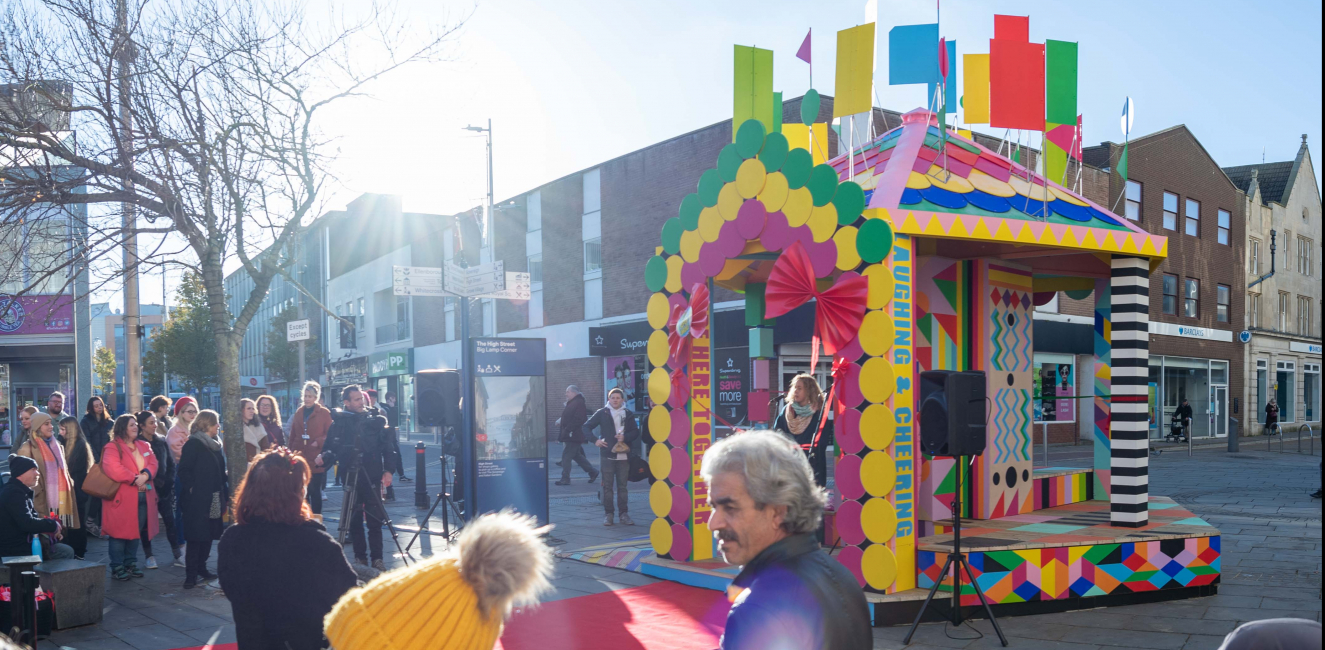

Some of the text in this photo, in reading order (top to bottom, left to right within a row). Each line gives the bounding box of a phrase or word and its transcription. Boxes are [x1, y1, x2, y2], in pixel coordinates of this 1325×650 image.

[289, 322, 307, 331] Except
[1184, 327, 1204, 337] BARCLAYS
[290, 330, 307, 339] cycles
[692, 346, 711, 399] HERE
[719, 380, 741, 391] save
[893, 234, 913, 538] LAUGHING & CHEERING
[719, 391, 742, 402] more
